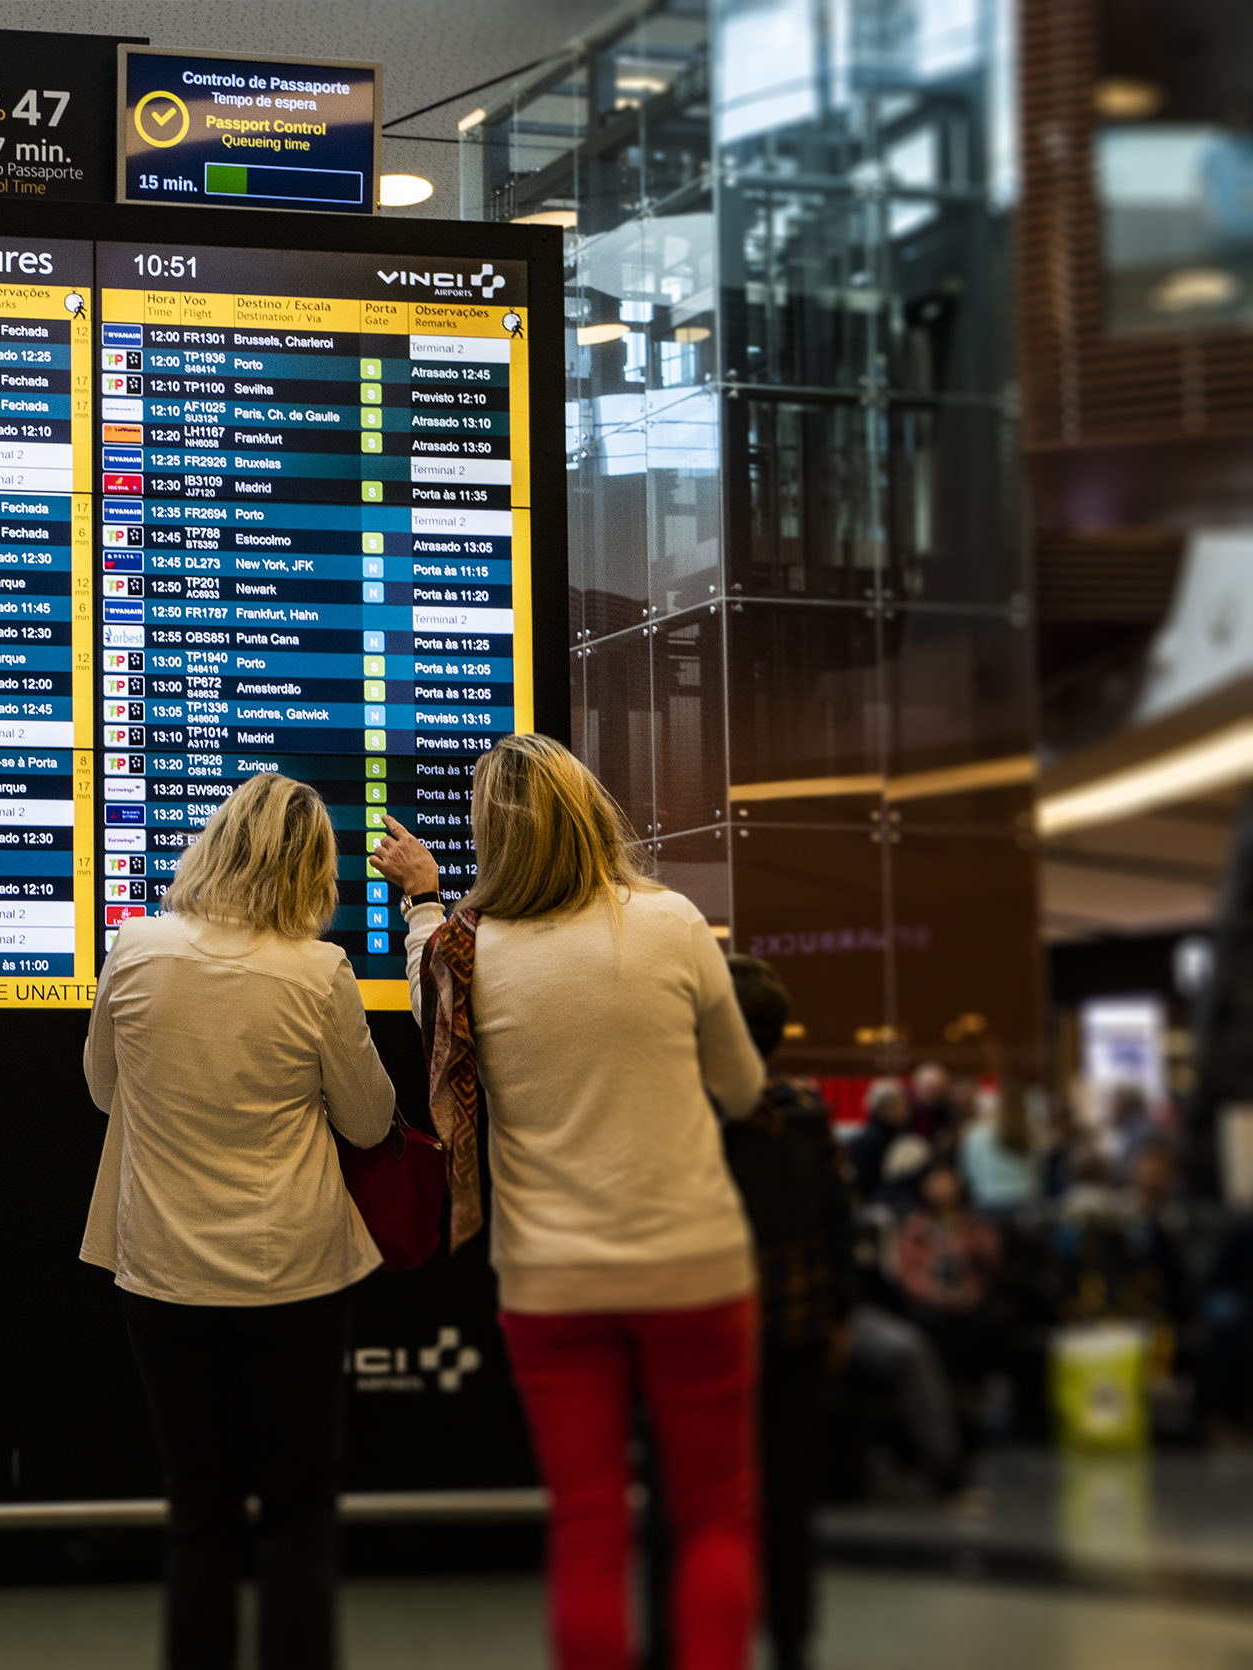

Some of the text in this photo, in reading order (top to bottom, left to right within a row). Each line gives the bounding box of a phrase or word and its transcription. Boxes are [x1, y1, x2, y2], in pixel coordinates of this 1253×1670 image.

[183, 71, 350, 95] Controlo de Passaporte
[12, 90, 70, 126] 47
[212, 92, 317, 111] Tempo de espera
[206, 115, 326, 135] Passport Control
[16, 139, 71, 163] min.
[222, 134, 310, 151] Queueing time
[8, 163, 83, 181] Passaporte
[12, 180, 46, 194] Time
[140, 175, 197, 192] 15 min.
[134, 254, 195, 277] 10:51
[377, 271, 462, 287] VINCI
[435, 289, 472, 297] AIRPORTS
[1, 325, 48, 337] Fechada
[150, 331, 463, 353] 12:00 FR1301 Brussels, Charleroi Terminal 2
[21, 426, 51, 437] 12:10
[152, 557, 488, 577] 12:45 DL273 New York, JFK Porta às 11:15
[113, 630, 143, 645] orbest
[153, 702, 491, 724] 13:05 TP1336 Londres, Gatwick Previsto 13:15
[18, 729, 24, 738] 2
